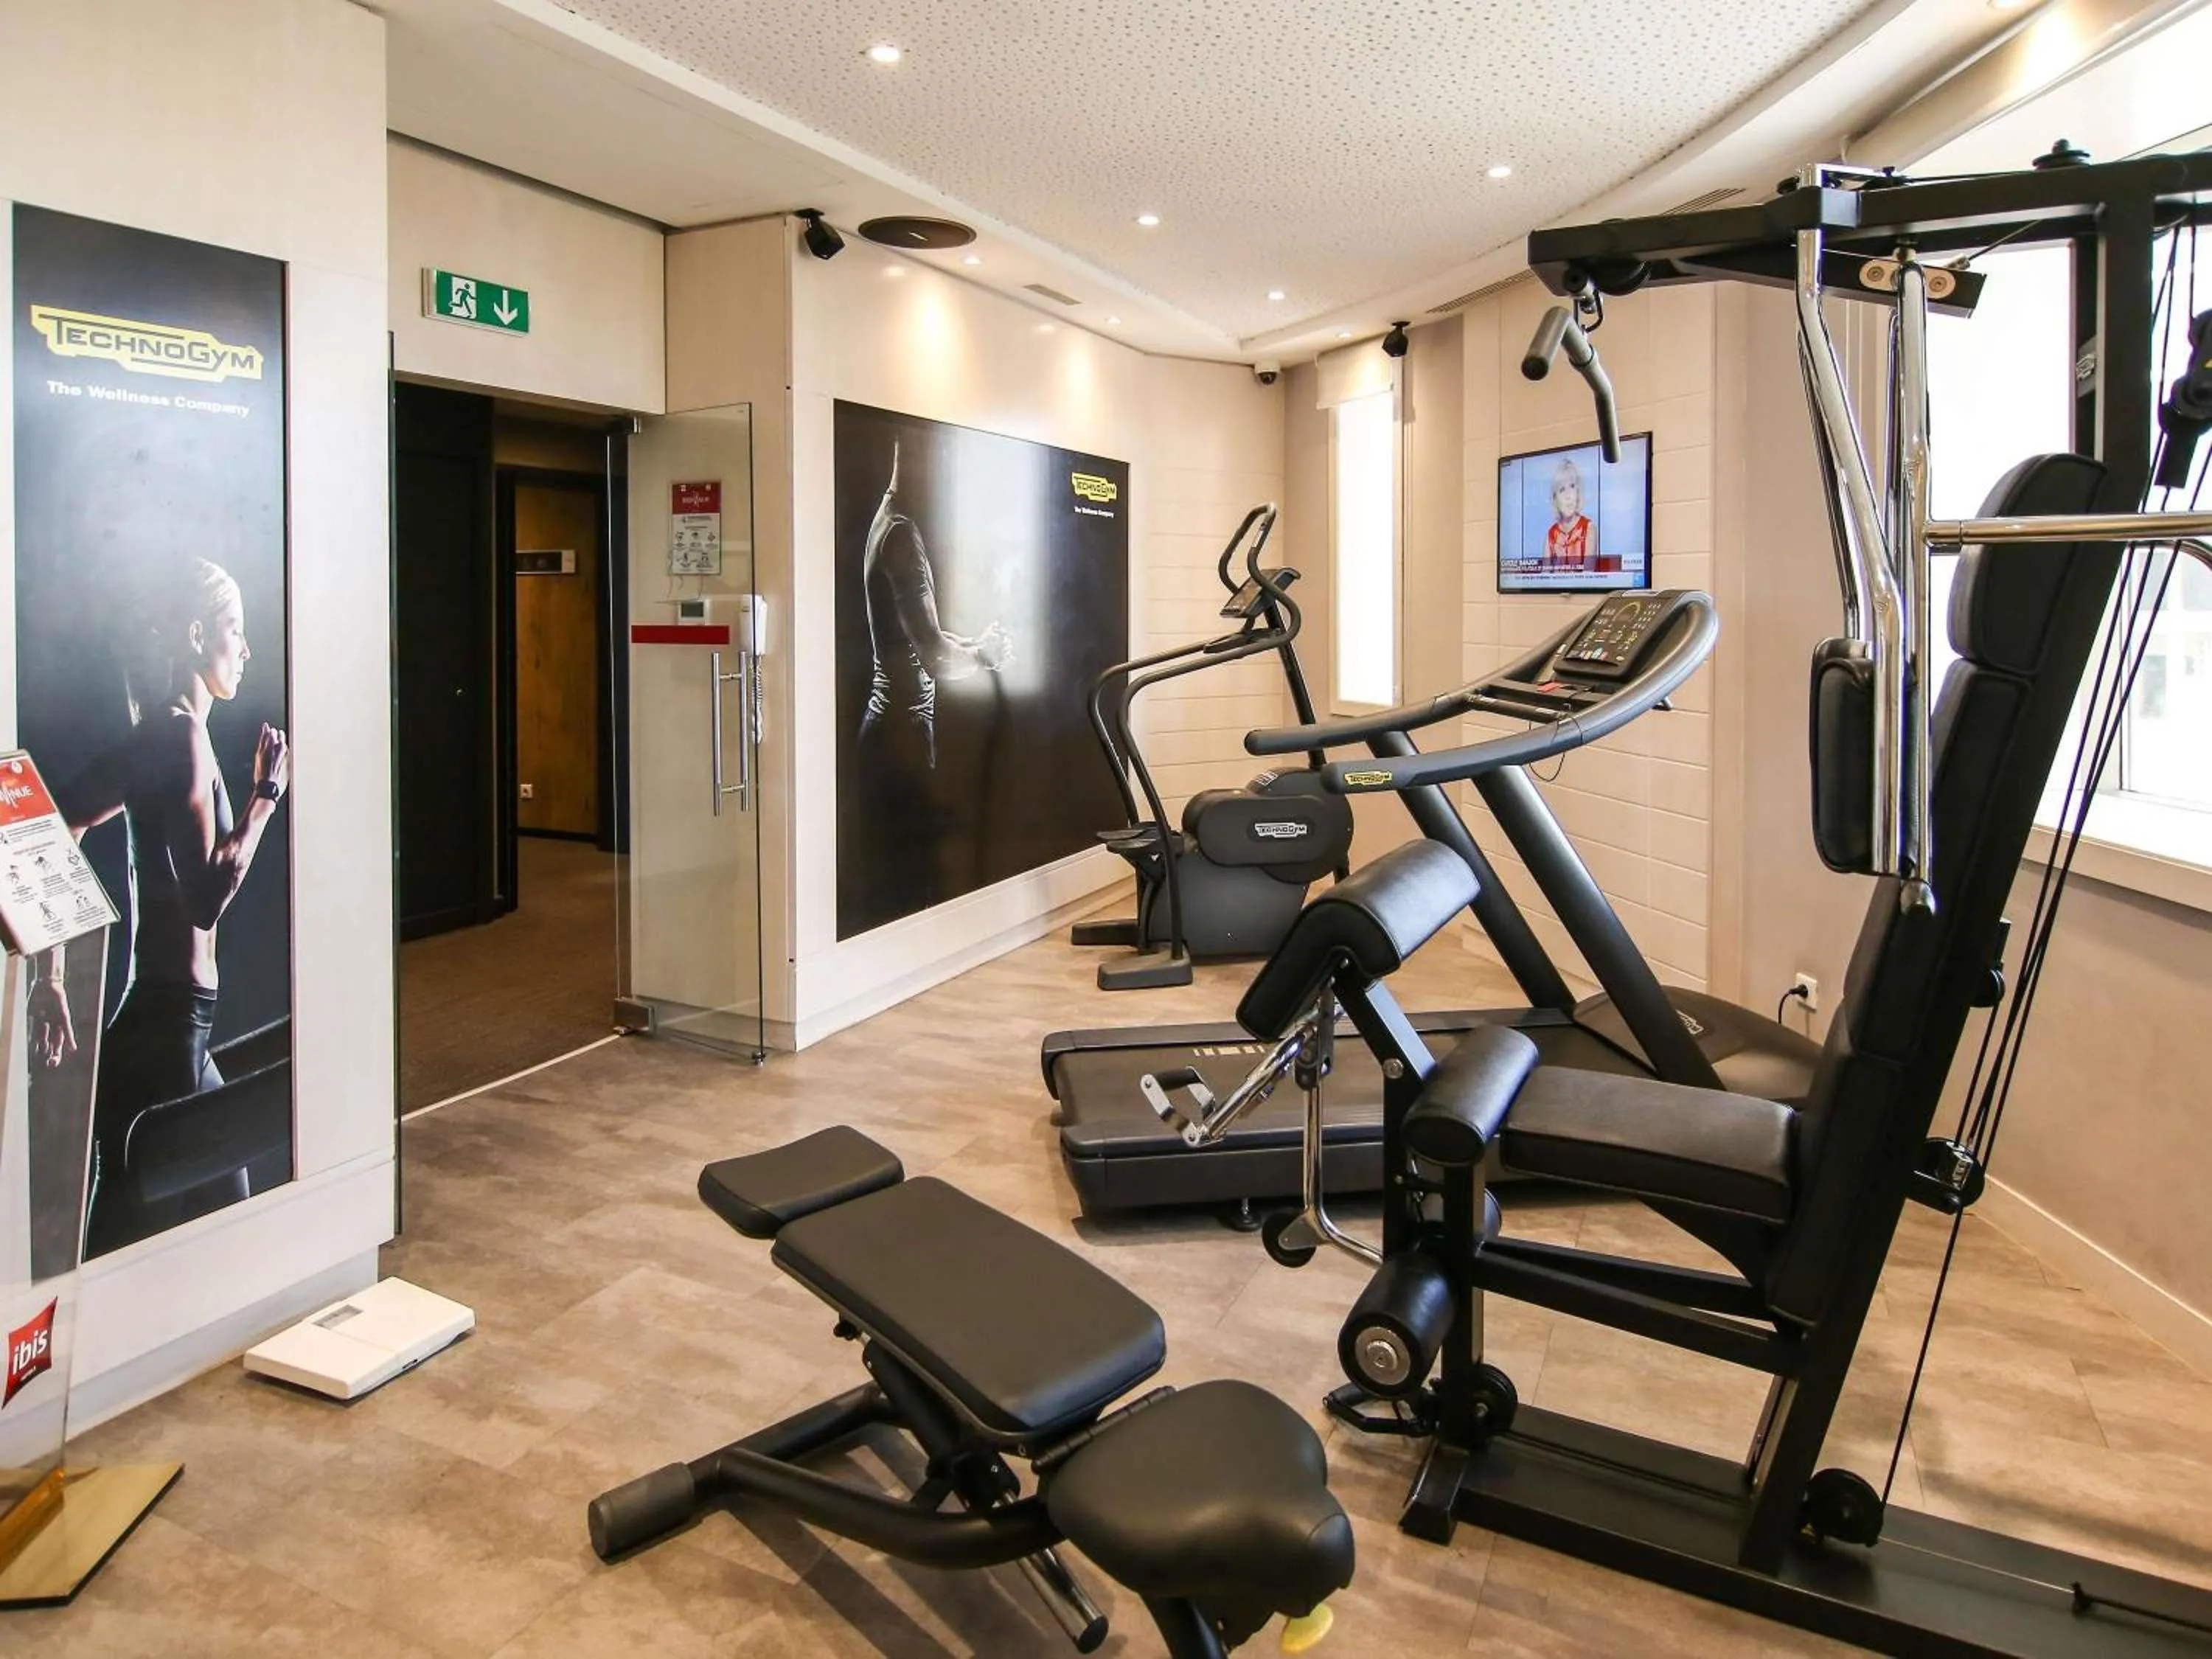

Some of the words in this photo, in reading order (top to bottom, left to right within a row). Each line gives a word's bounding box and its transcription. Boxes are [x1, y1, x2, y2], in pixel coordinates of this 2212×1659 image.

[46, 380, 82, 397] The
[88, 384, 171, 407] Wellness
[174, 396, 251, 418] Company
[12, 1329, 49, 1376] ibis
